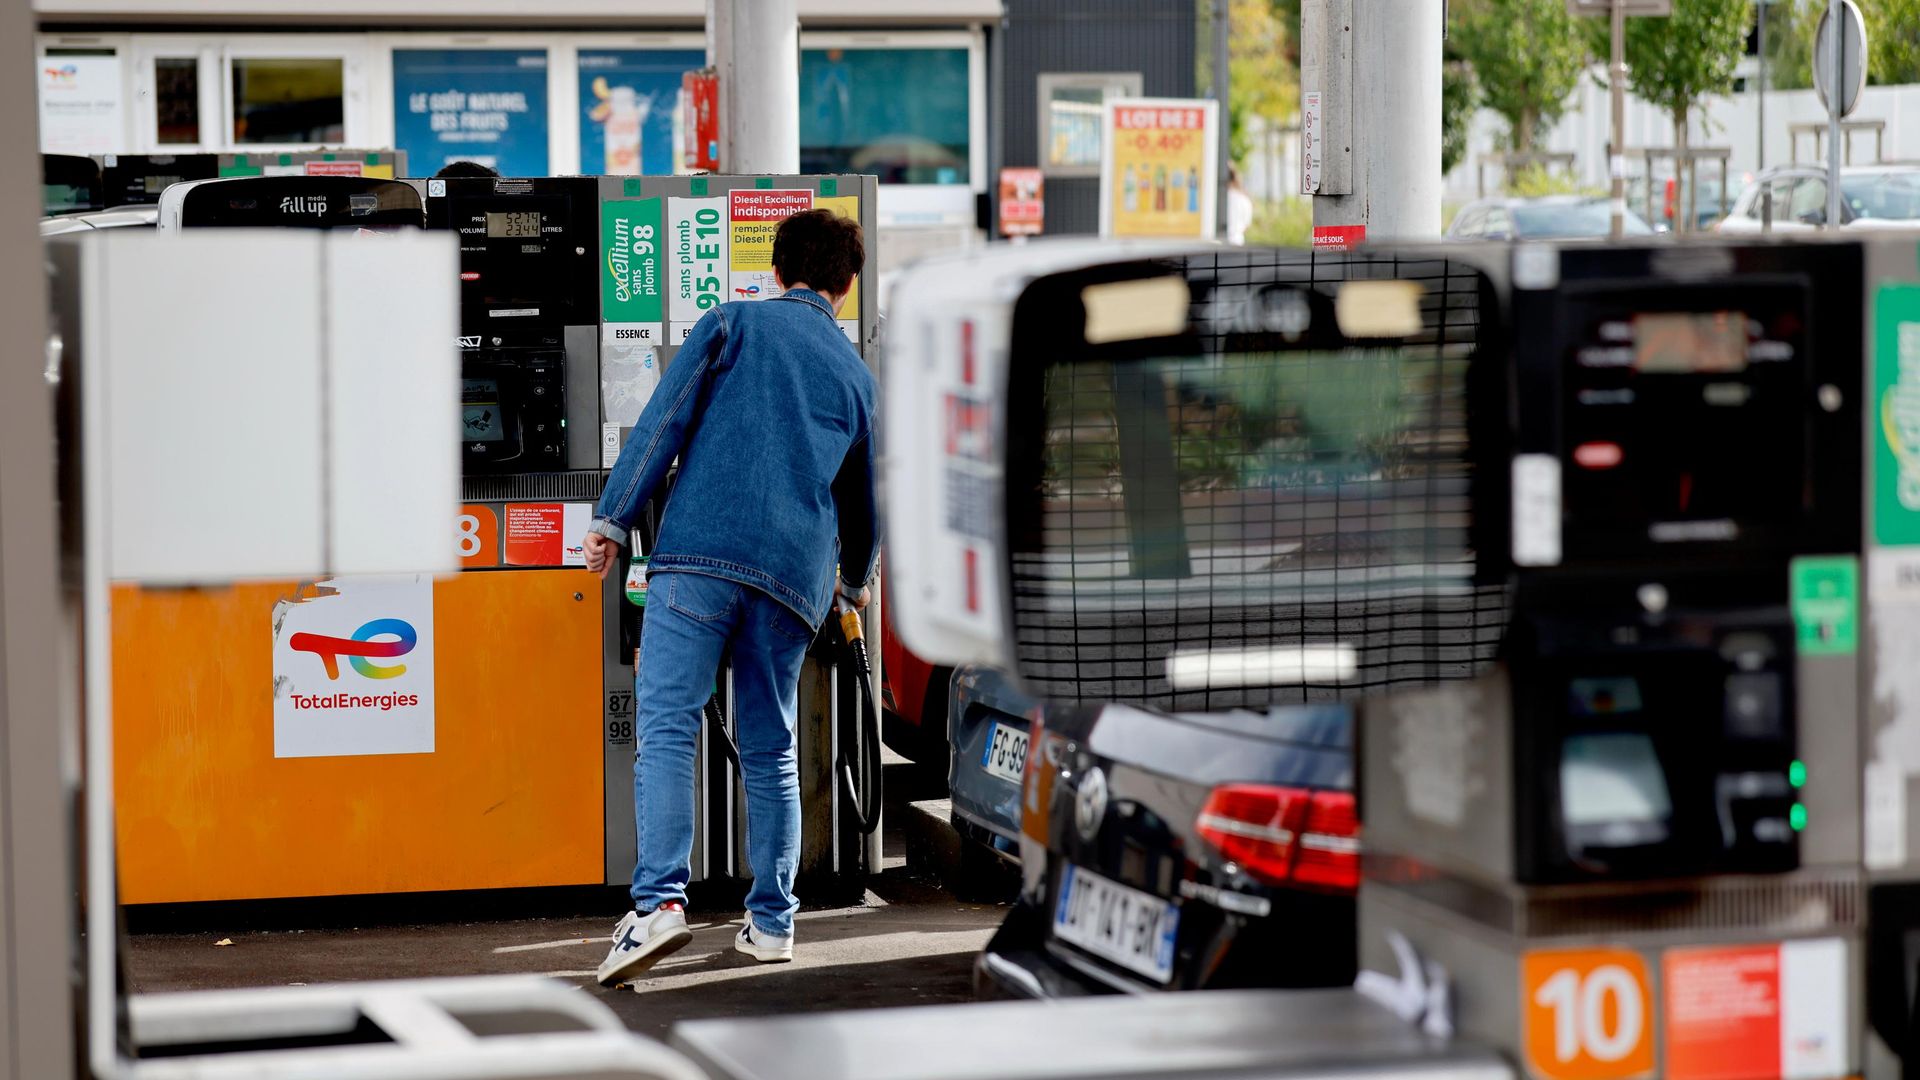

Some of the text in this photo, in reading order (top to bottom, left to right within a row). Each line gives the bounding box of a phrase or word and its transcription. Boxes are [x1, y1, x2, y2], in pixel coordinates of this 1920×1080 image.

[409, 93, 427, 113] LE
[280, 196, 327, 217] fill up
[734, 196, 808, 204] Diesel Excellium
[734, 235, 765, 243] Diesel
[612, 218, 630, 302] excellium
[633, 225, 657, 295] plomb 98
[677, 220, 694, 299] sans plomb
[633, 269, 641, 295] sans
[615, 329, 650, 339] ESSENCE
[456, 514, 481, 557] 8
[291, 691, 418, 711] TotalEnergies
[609, 695, 631, 712] 87
[609, 721, 631, 738] 98
[990, 728, 1028, 774] FG-99
[1534, 965, 1643, 1062] 10
